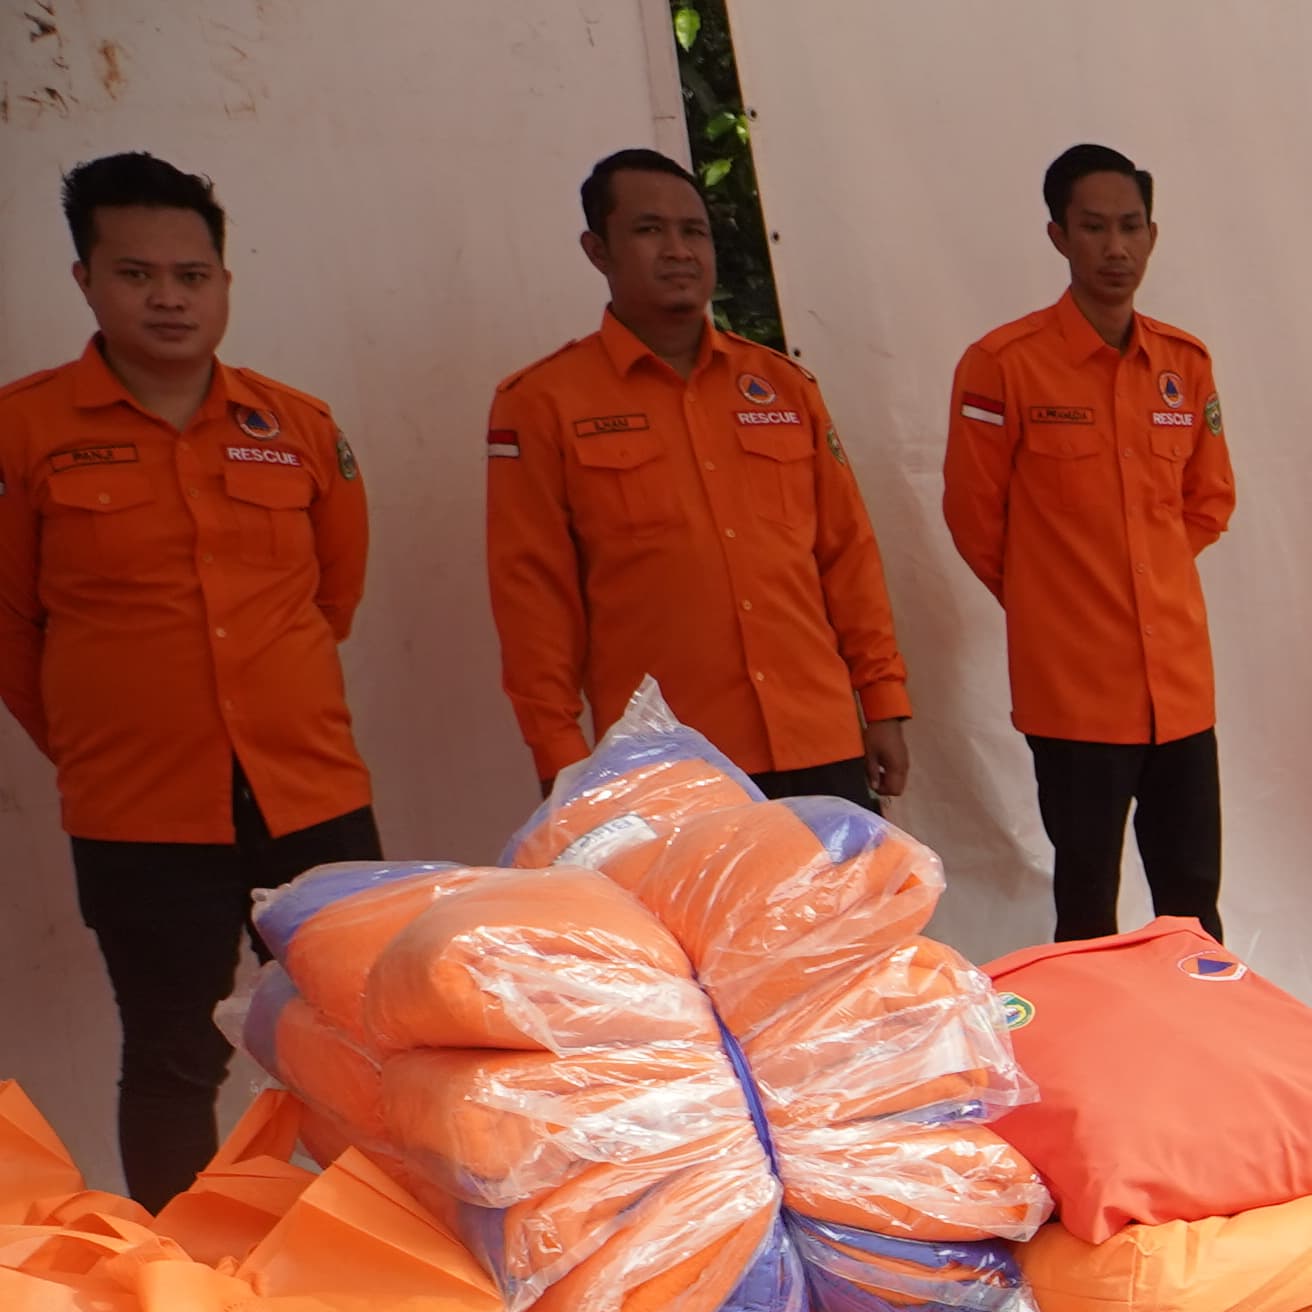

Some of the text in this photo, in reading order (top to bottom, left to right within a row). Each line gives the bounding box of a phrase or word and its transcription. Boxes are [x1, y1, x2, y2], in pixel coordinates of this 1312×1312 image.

[737, 411, 800, 425] RESCUE
[1152, 412, 1194, 426] RESCUE
[227, 447, 300, 466] RESCUE
